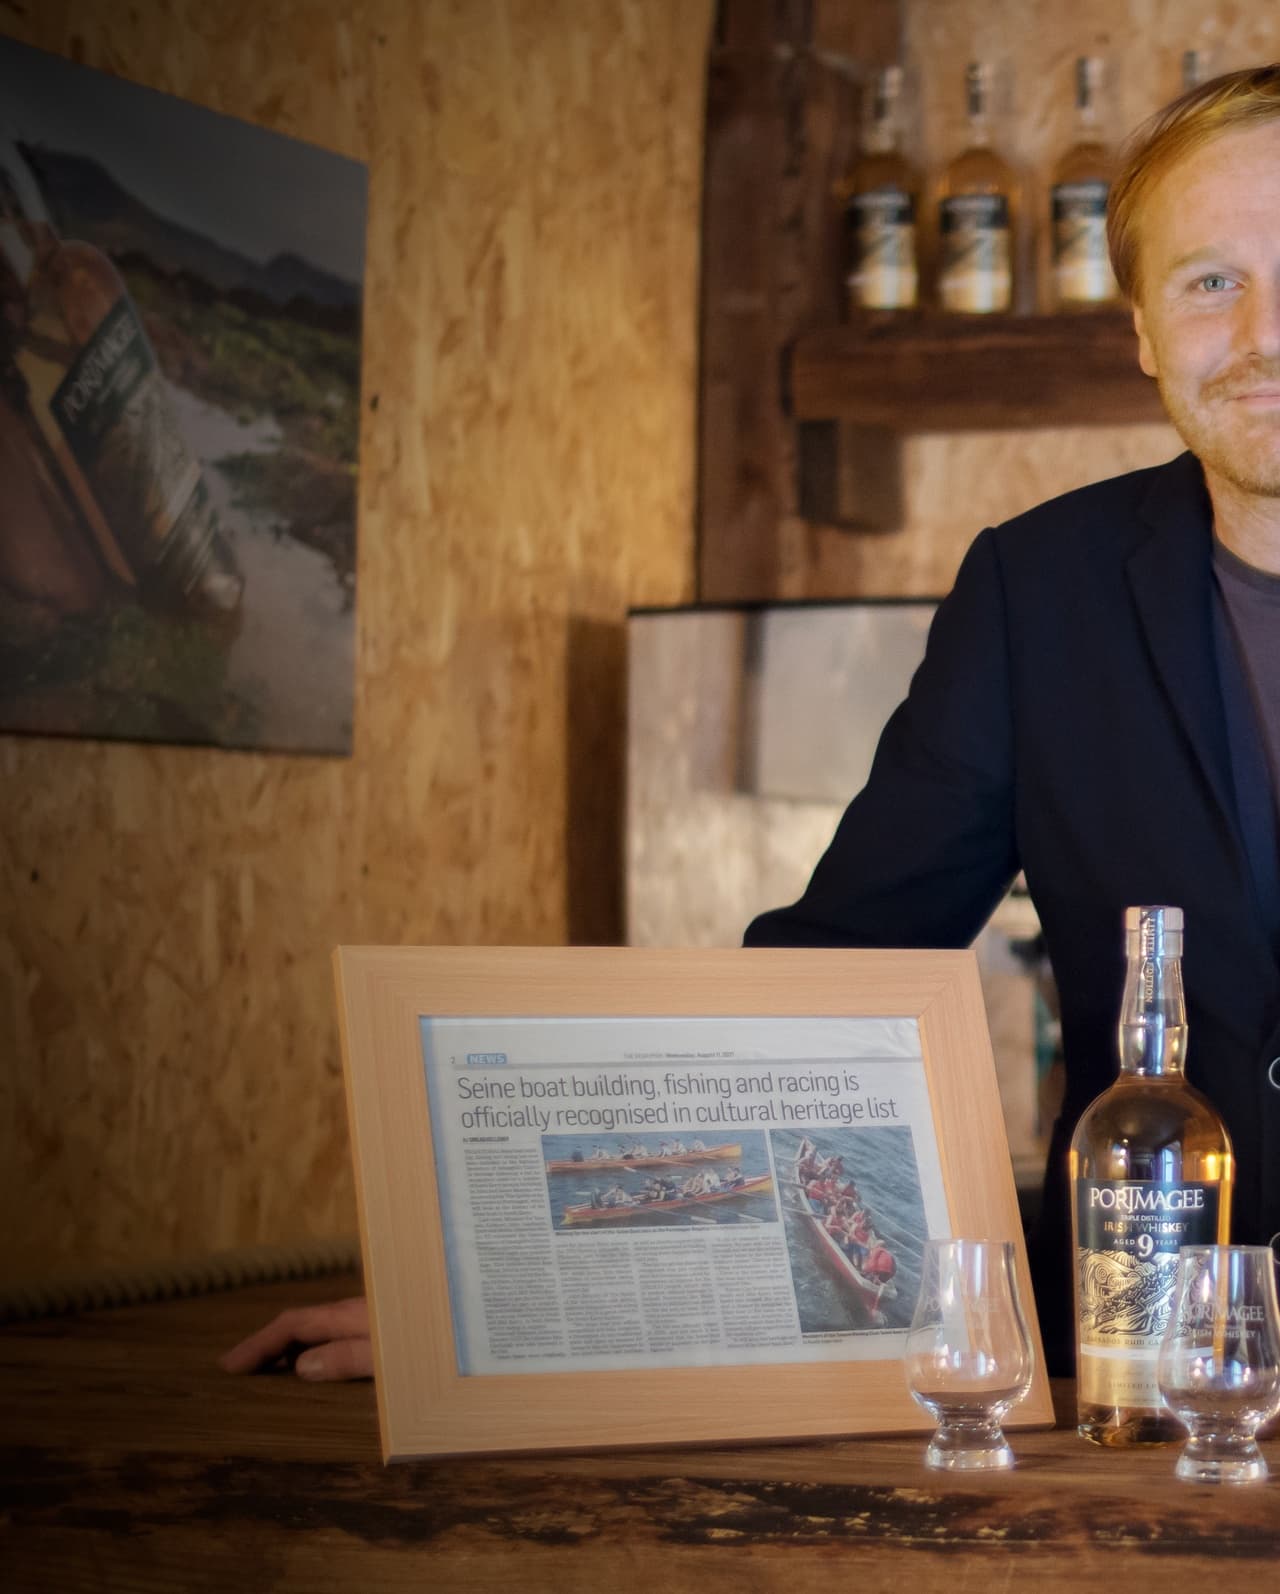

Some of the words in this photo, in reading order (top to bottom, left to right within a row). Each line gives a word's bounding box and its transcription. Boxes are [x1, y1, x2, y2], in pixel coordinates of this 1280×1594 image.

[1144, 961, 1155, 1003] EDITION
[469, 1054, 505, 1064] NEWS
[457, 1077, 516, 1099] Seine
[519, 1076, 569, 1098] boat
[572, 1074, 661, 1100] building,
[664, 1072, 732, 1099] fishing
[735, 1071, 774, 1095] and
[778, 1070, 840, 1097] racing
[843, 1069, 860, 1091] is
[461, 1104, 551, 1132] officially
[556, 1101, 669, 1130] recognised
[672, 1101, 692, 1123] in
[695, 1099, 778, 1123] cultural
[780, 1098, 864, 1124] heritage
[867, 1096, 900, 1119] list
[1090, 1186, 1205, 1213] PORTMAGEE
[1134, 1222, 1188, 1233] WHISKEY
[1137, 1233, 1154, 1257] 9
